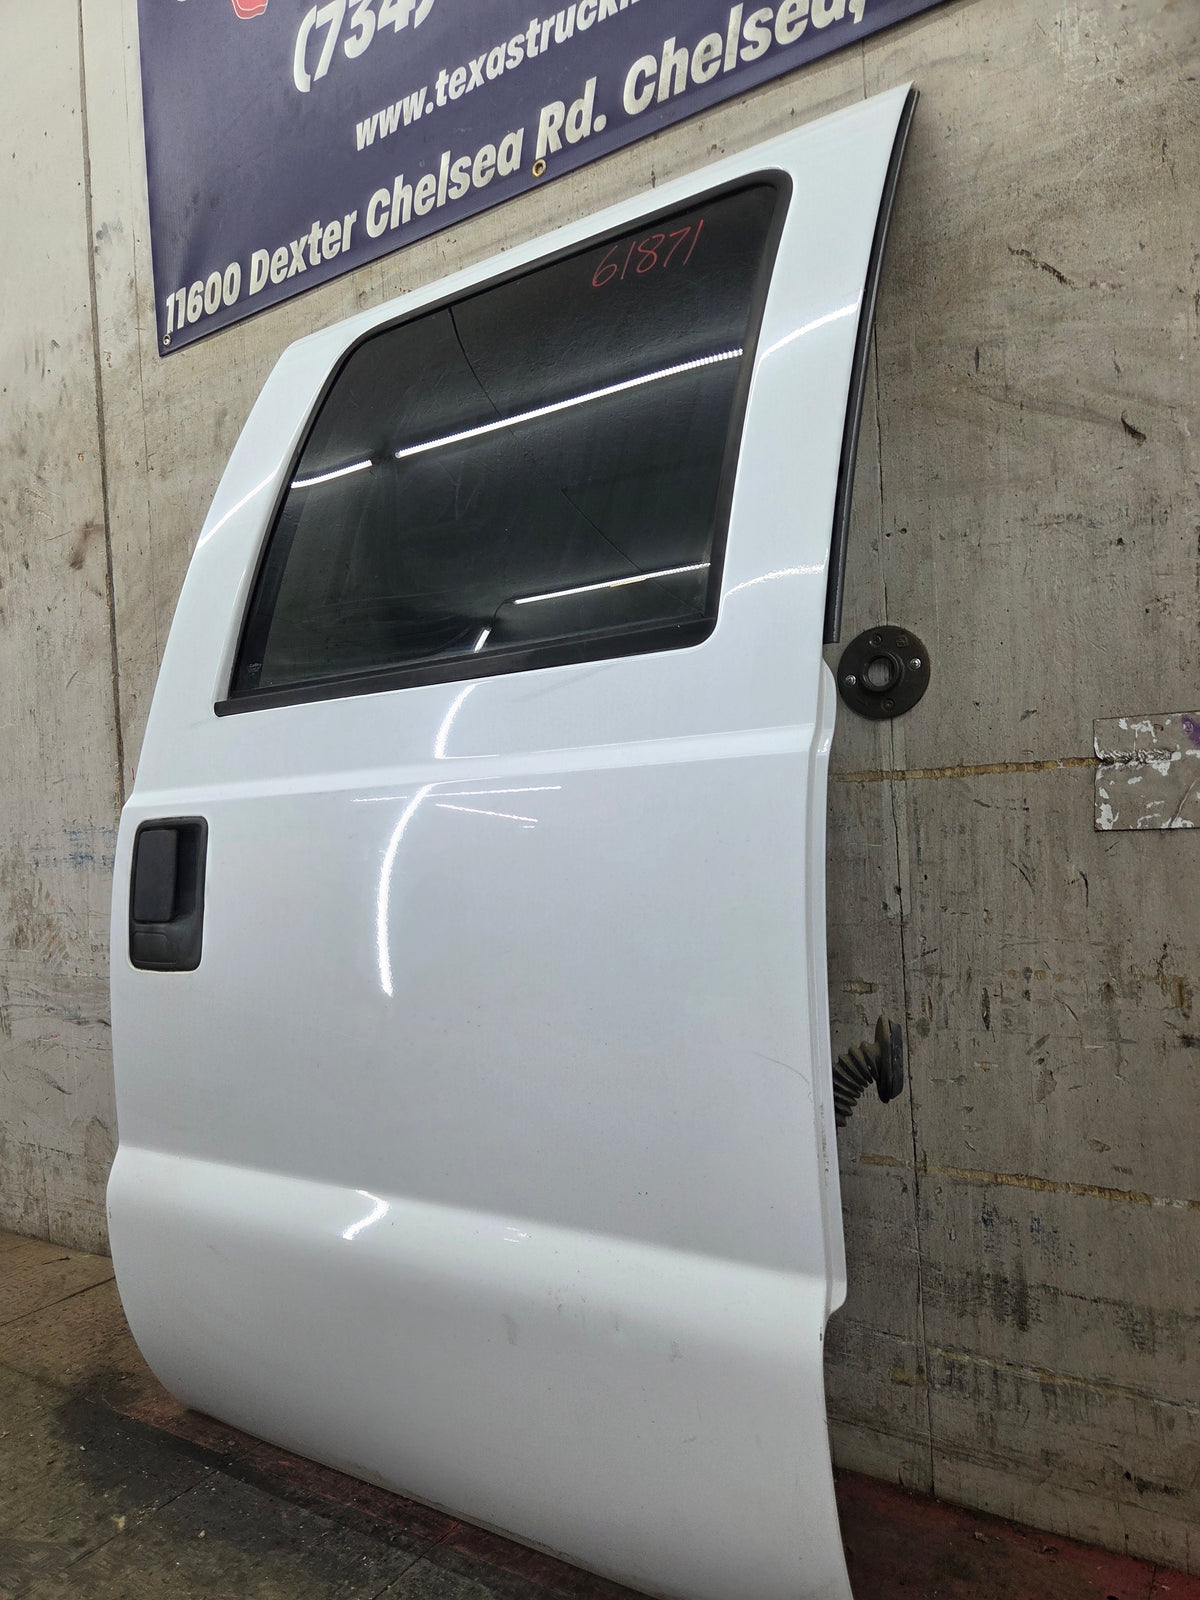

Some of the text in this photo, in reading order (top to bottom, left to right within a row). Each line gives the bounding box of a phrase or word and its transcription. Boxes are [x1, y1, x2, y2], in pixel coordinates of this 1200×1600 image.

[356, 0, 640, 151] www.texastruck
[165, 261, 242, 333] 11600
[249, 210, 358, 296] Dexter
[366, 128, 525, 238] Chelsea
[535, 76, 607, 161] Rd.
[591, 219, 704, 287] 61871
